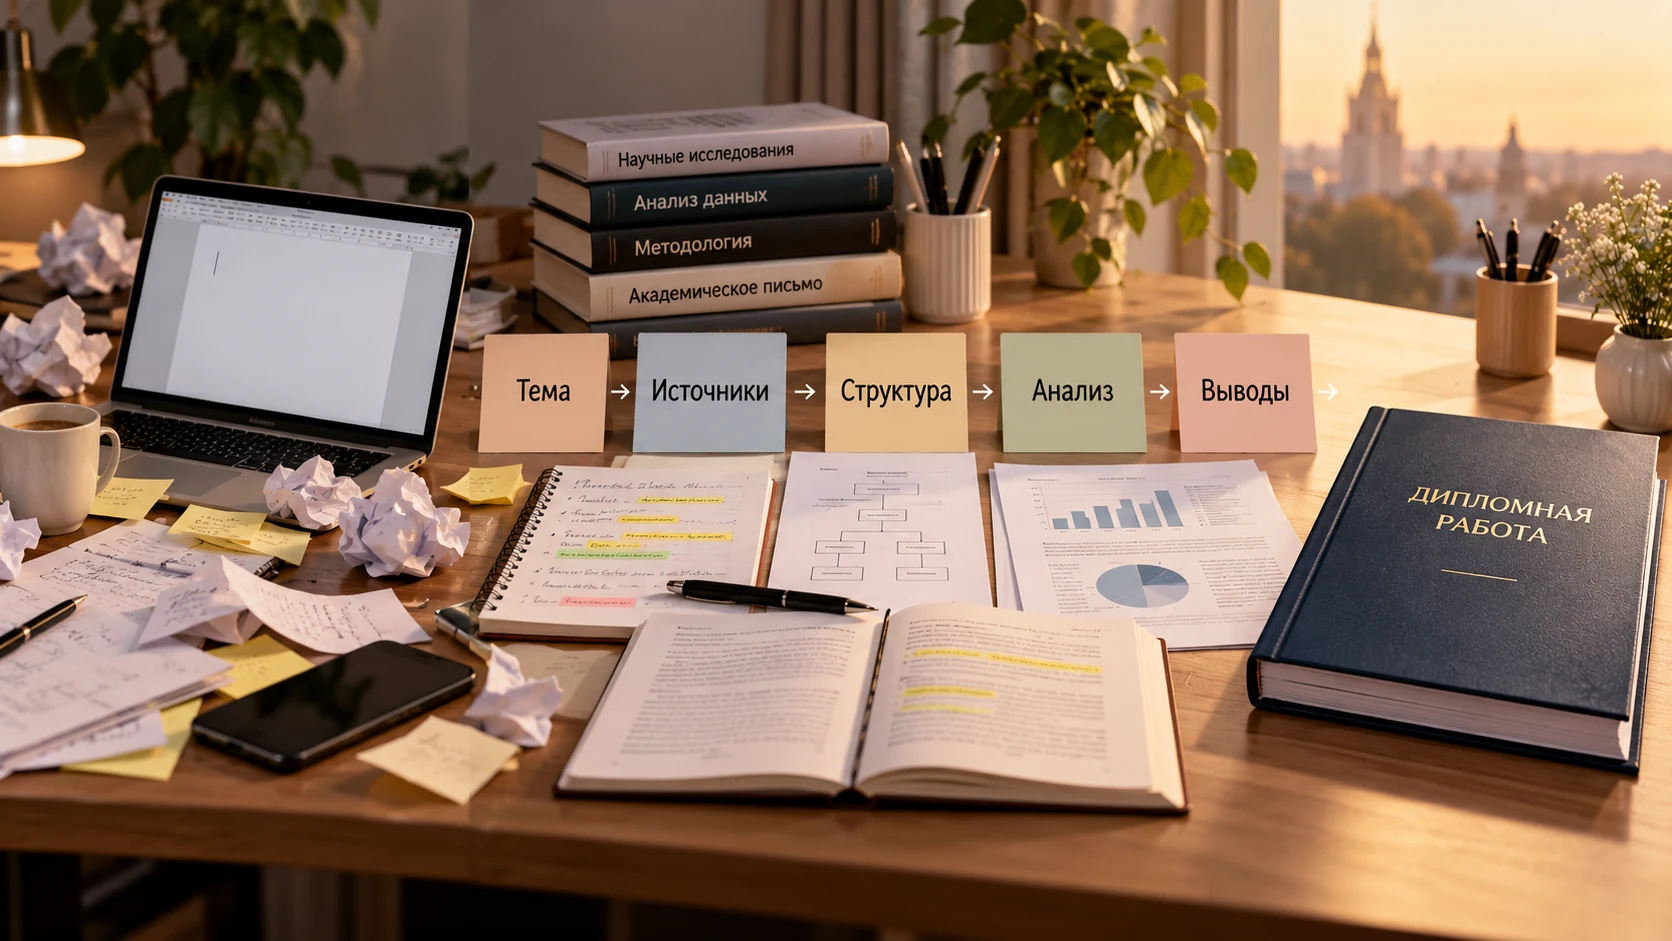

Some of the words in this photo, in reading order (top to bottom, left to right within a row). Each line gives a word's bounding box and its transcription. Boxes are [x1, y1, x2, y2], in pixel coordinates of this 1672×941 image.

[618, 149, 685, 169] Научные
[689, 144, 794, 162] исследования
[634, 194, 698, 211] Анализ
[703, 189, 768, 209] данных
[635, 235, 752, 256] Методология
[628, 282, 758, 304] Академическое
[763, 277, 823, 294] письмо
[516, 378, 571, 402] Тема
[652, 378, 769, 402] Источники
[840, 378, 952, 408] Структура
[1032, 378, 1114, 402] Анализ
[1201, 378, 1290, 405] Выводы
[1407, 486, 1593, 523] ДИПЛОМНАЯ
[1435, 514, 1549, 544] РАБОТА
